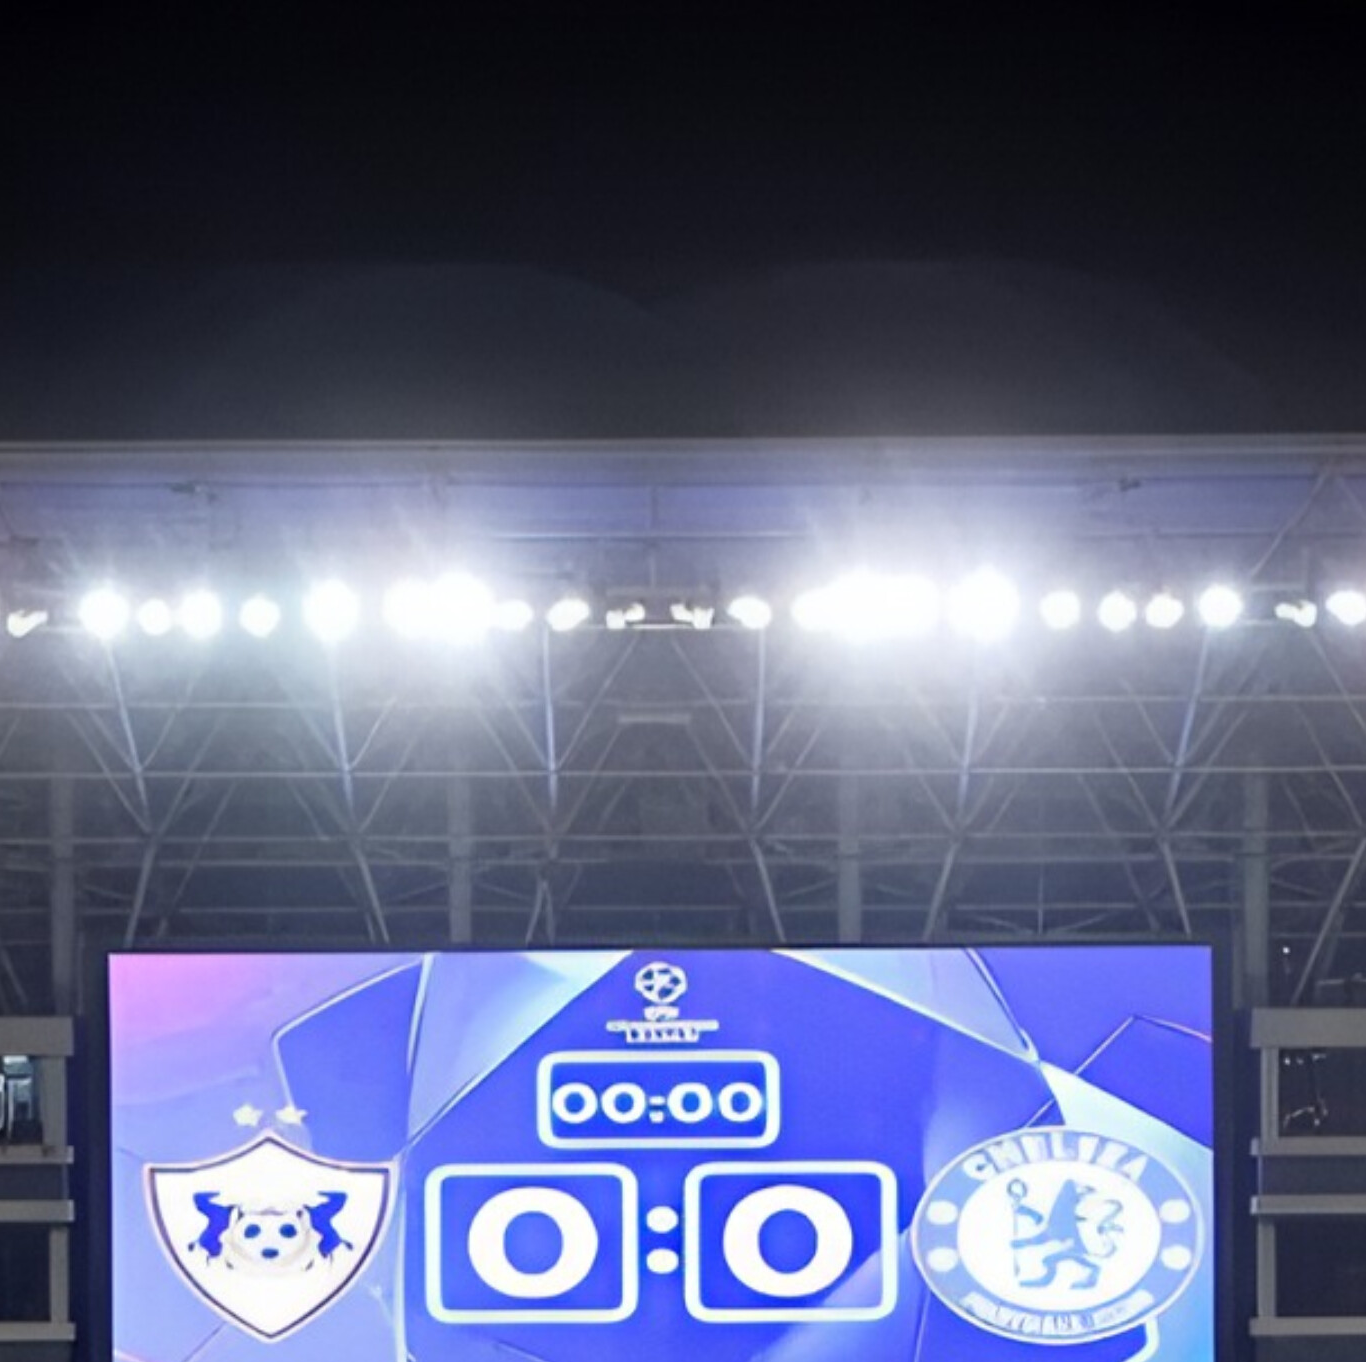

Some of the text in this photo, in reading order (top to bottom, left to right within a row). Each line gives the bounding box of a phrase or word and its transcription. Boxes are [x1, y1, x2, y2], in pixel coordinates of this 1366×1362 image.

[553, 1083, 761, 1122] 00:00
[469, 1188, 597, 1297] 0
[723, 1185, 853, 1296] 0
